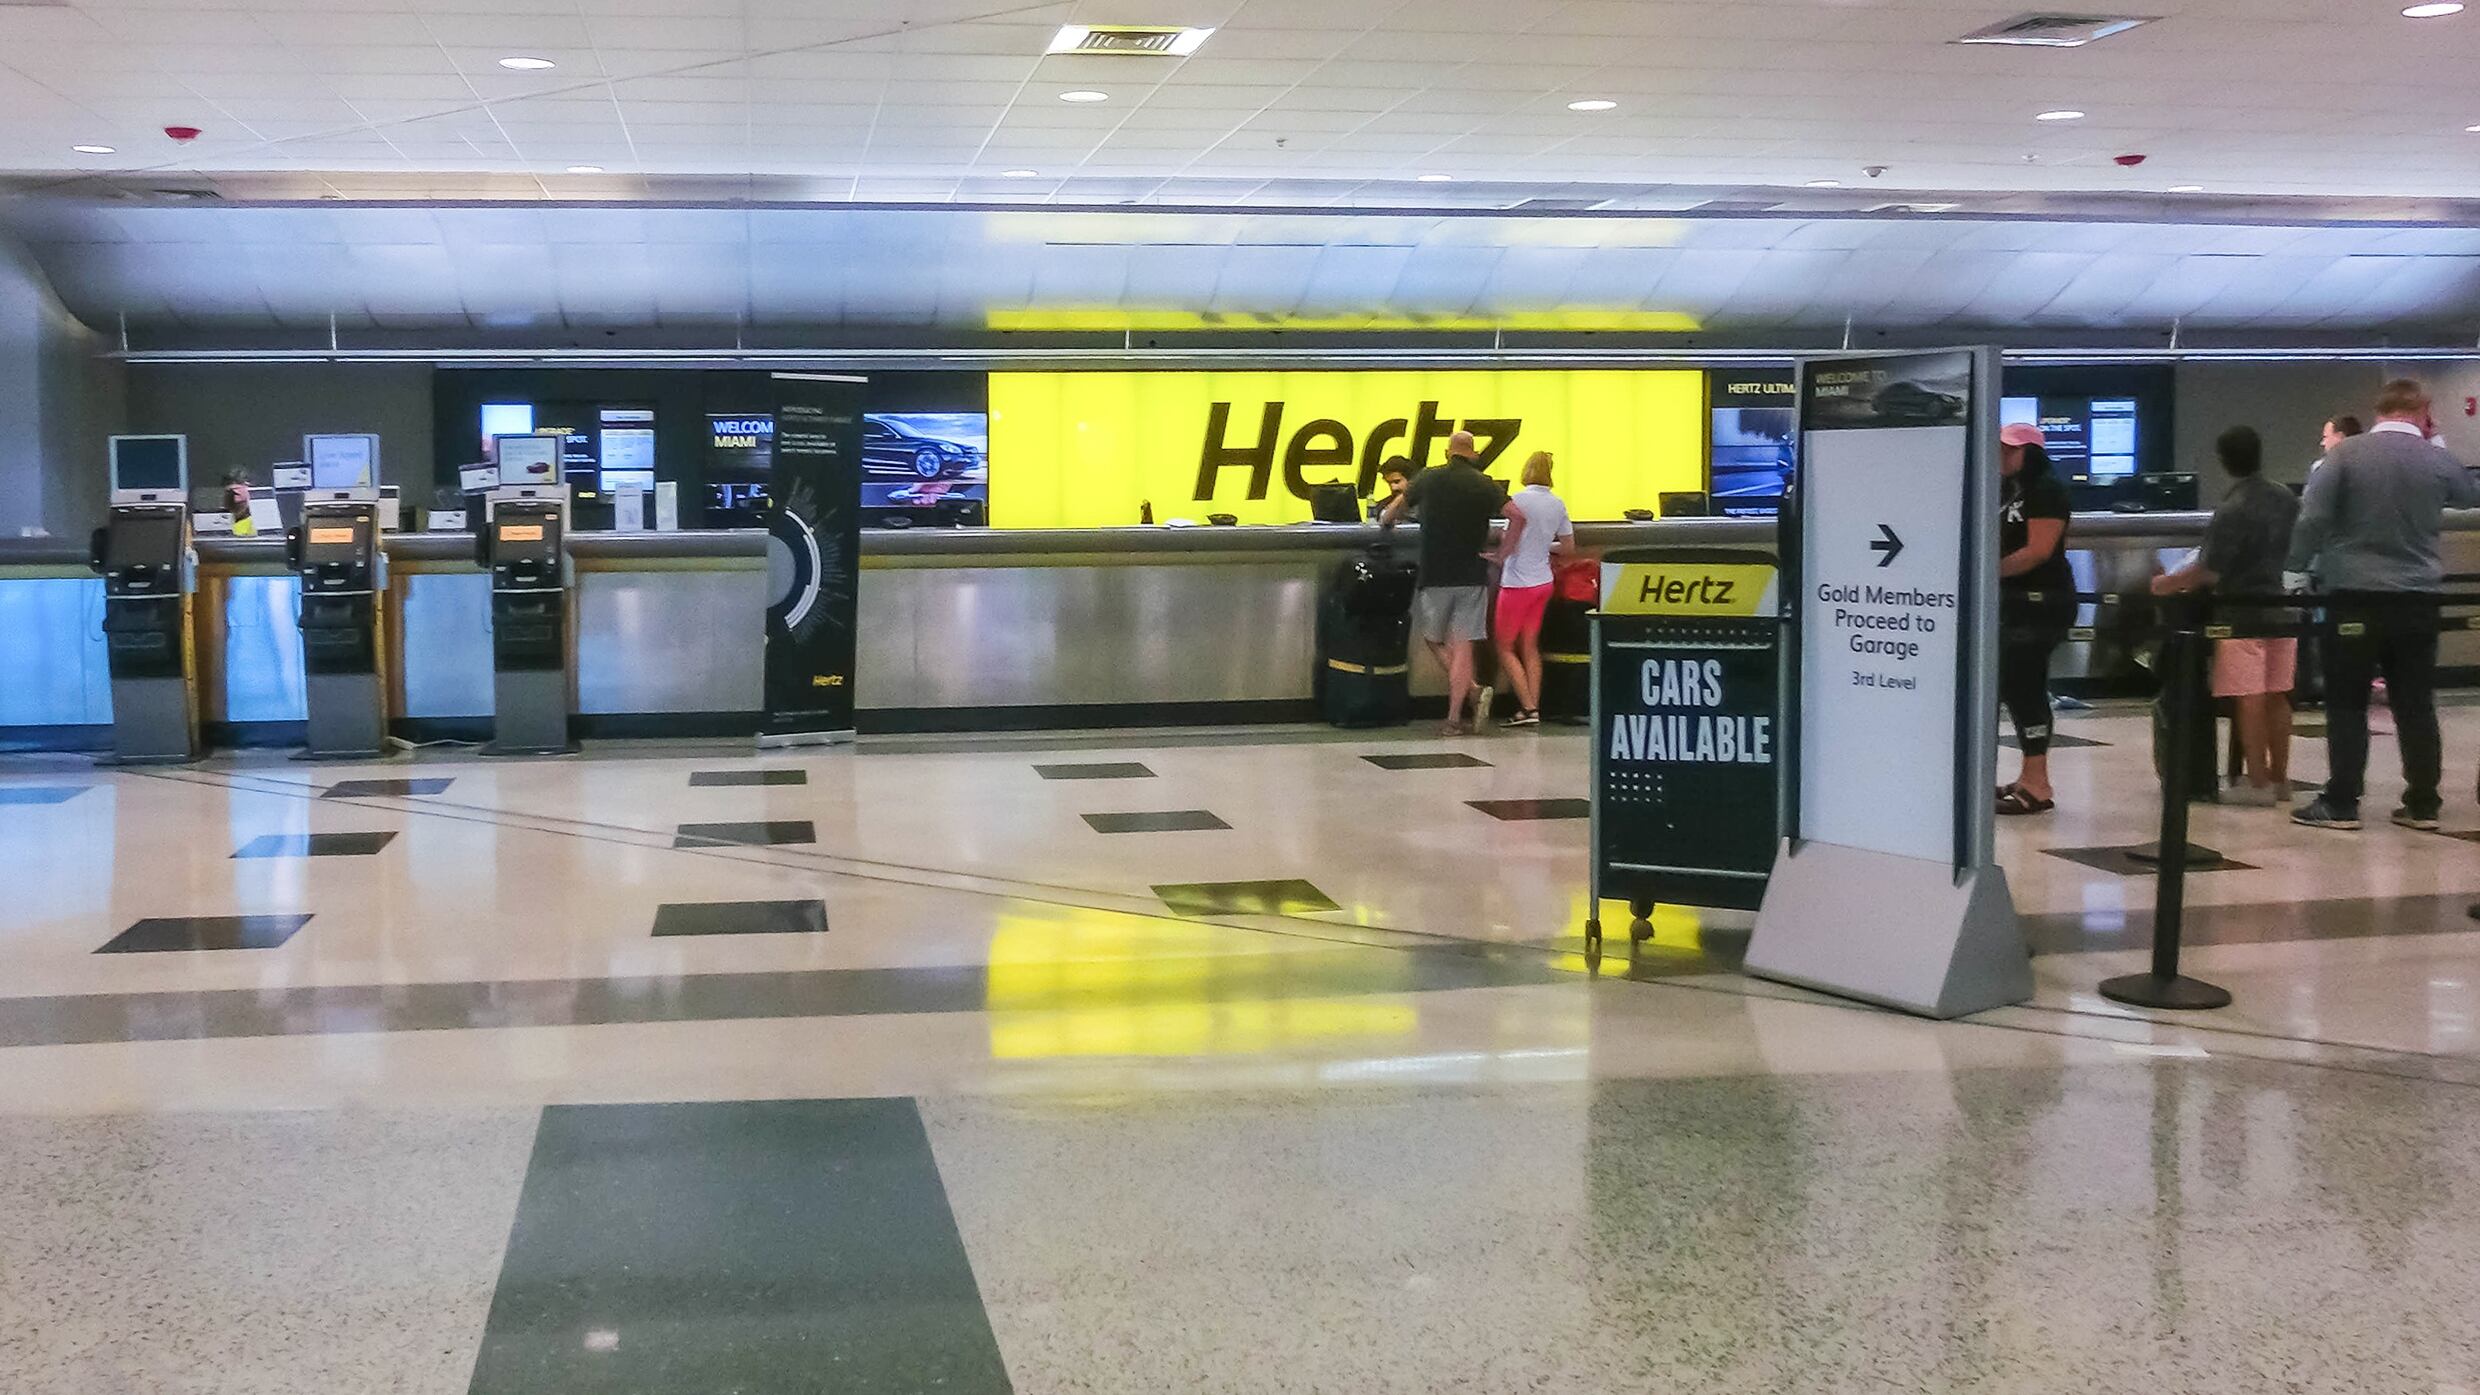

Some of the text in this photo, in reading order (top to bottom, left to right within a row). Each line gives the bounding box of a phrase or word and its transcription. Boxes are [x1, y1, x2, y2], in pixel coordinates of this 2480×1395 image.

[1728, 384, 1760, 394] HERTZ
[1815, 385, 1849, 397] MIAMI
[714, 436, 756, 447] MIAMI
[1192, 401, 1521, 500] Hertz
[1640, 575, 1735, 604] Hertz
[1817, 583, 1955, 608] Gold Members
[1835, 608, 1936, 632] Proceed to
[1850, 634, 1919, 660] Garage
[812, 675, 843, 686] Hertz
[1641, 659, 1722, 707] CARS
[1852, 671, 1916, 690] 3rd Level
[1610, 714, 1771, 763] AVAILABLE
